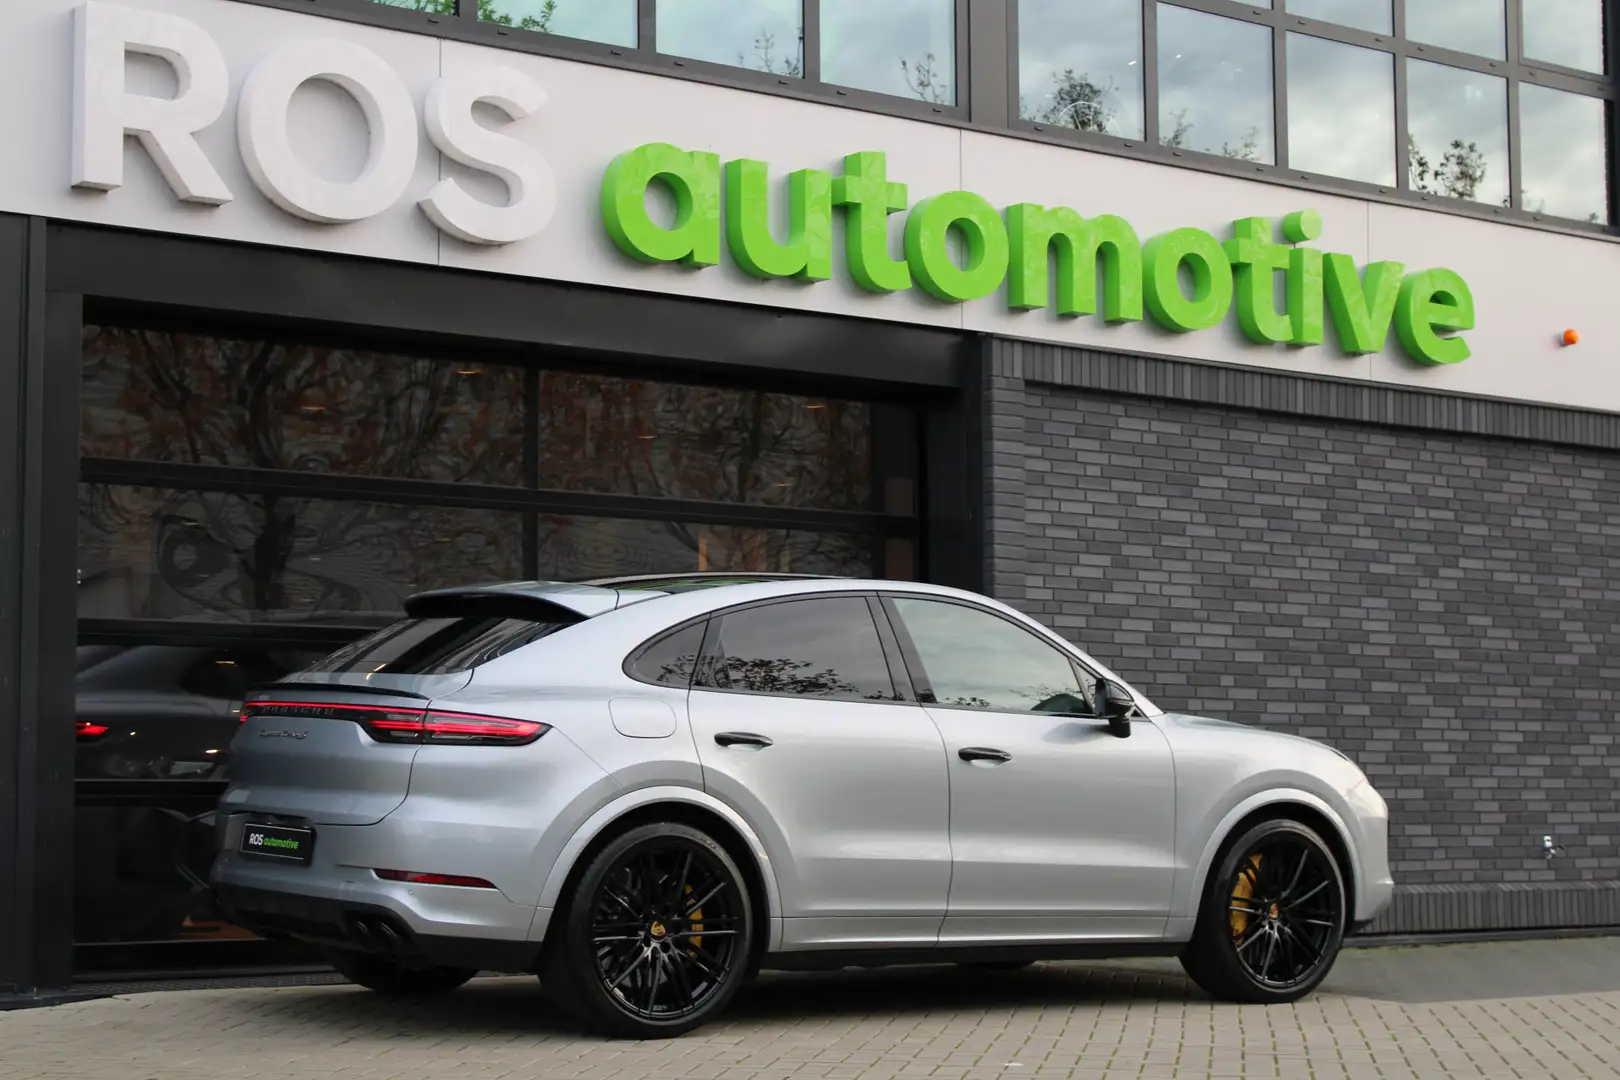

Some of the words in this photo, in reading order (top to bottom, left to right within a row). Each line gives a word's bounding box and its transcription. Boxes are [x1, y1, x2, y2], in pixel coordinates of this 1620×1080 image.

[71, 1, 557, 245] ROS
[602, 144, 1474, 364] automotive
[248, 833, 264, 846] ROS
[263, 837, 299, 850] automotive
